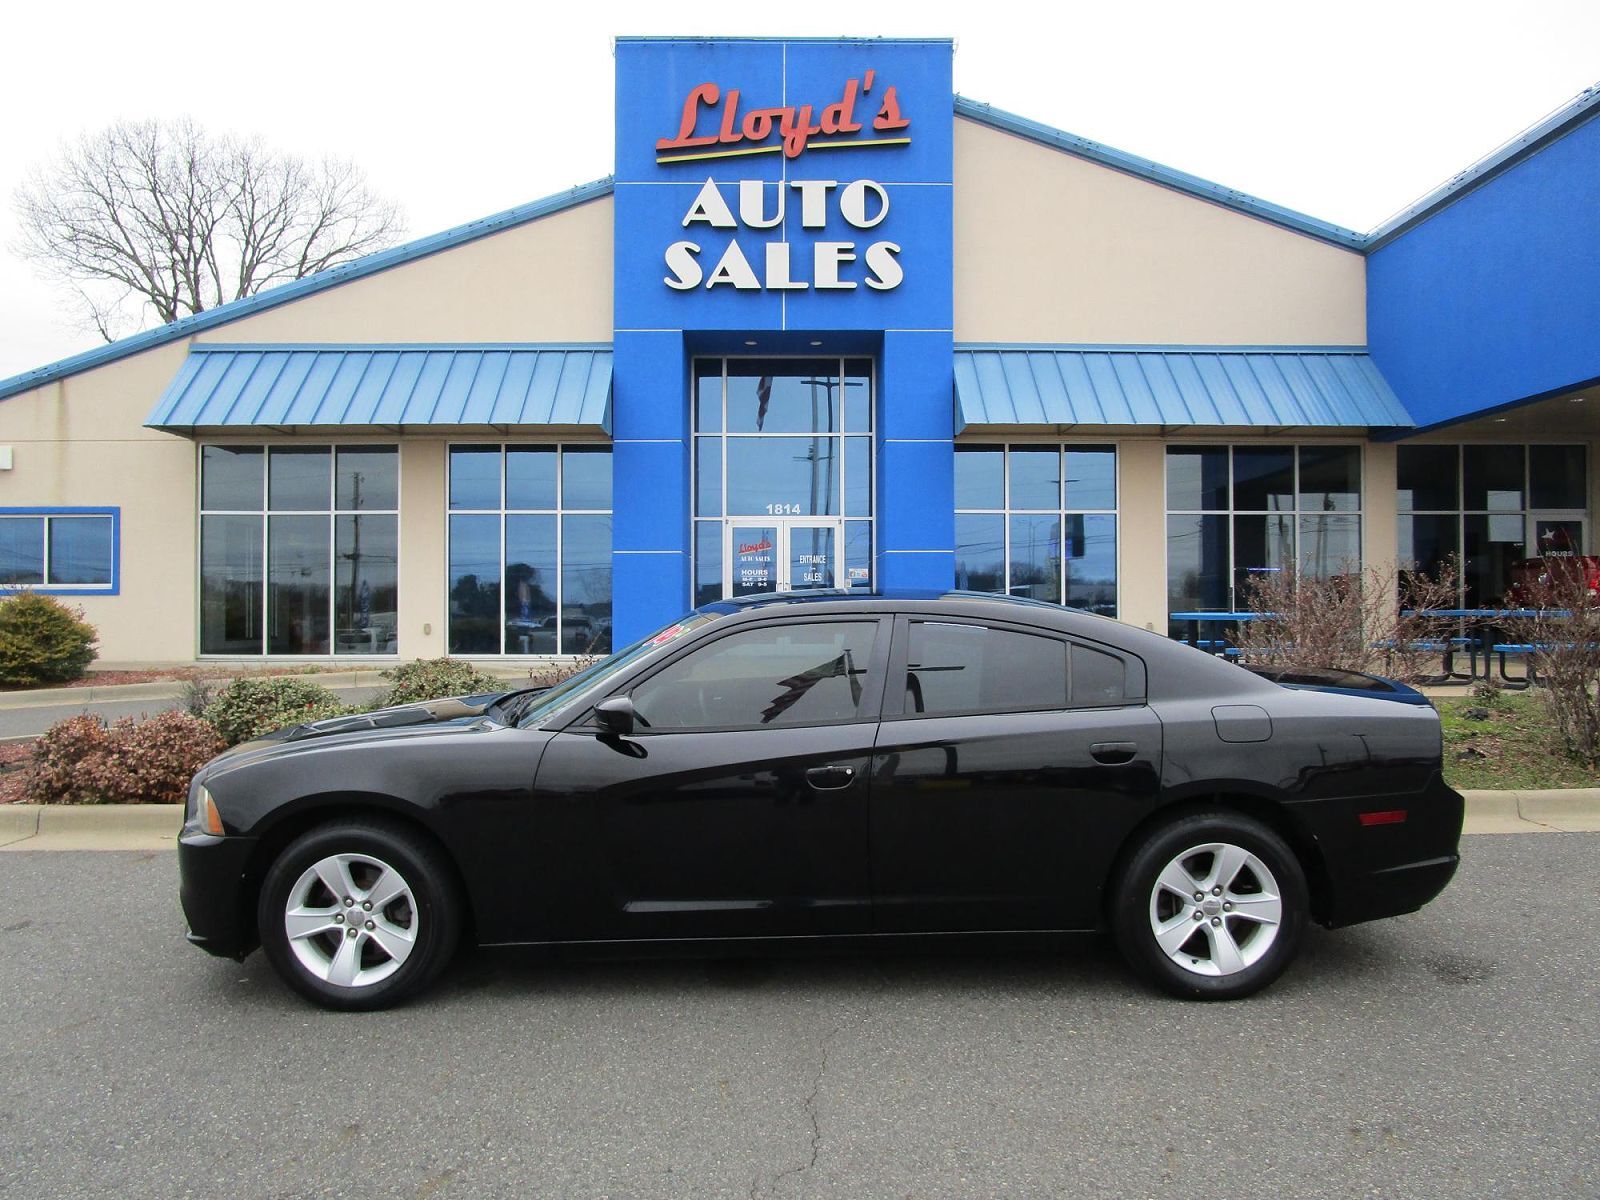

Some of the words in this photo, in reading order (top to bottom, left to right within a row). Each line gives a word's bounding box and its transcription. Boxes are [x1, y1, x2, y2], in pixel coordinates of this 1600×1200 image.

[656, 69, 911, 158] Lloyd's
[682, 177, 889, 228] AUTO
[664, 239, 904, 290] SALES
[766, 504, 801, 514] 1814
[799, 555, 826, 564] ENTRANCE
[803, 572, 822, 581] SALES
